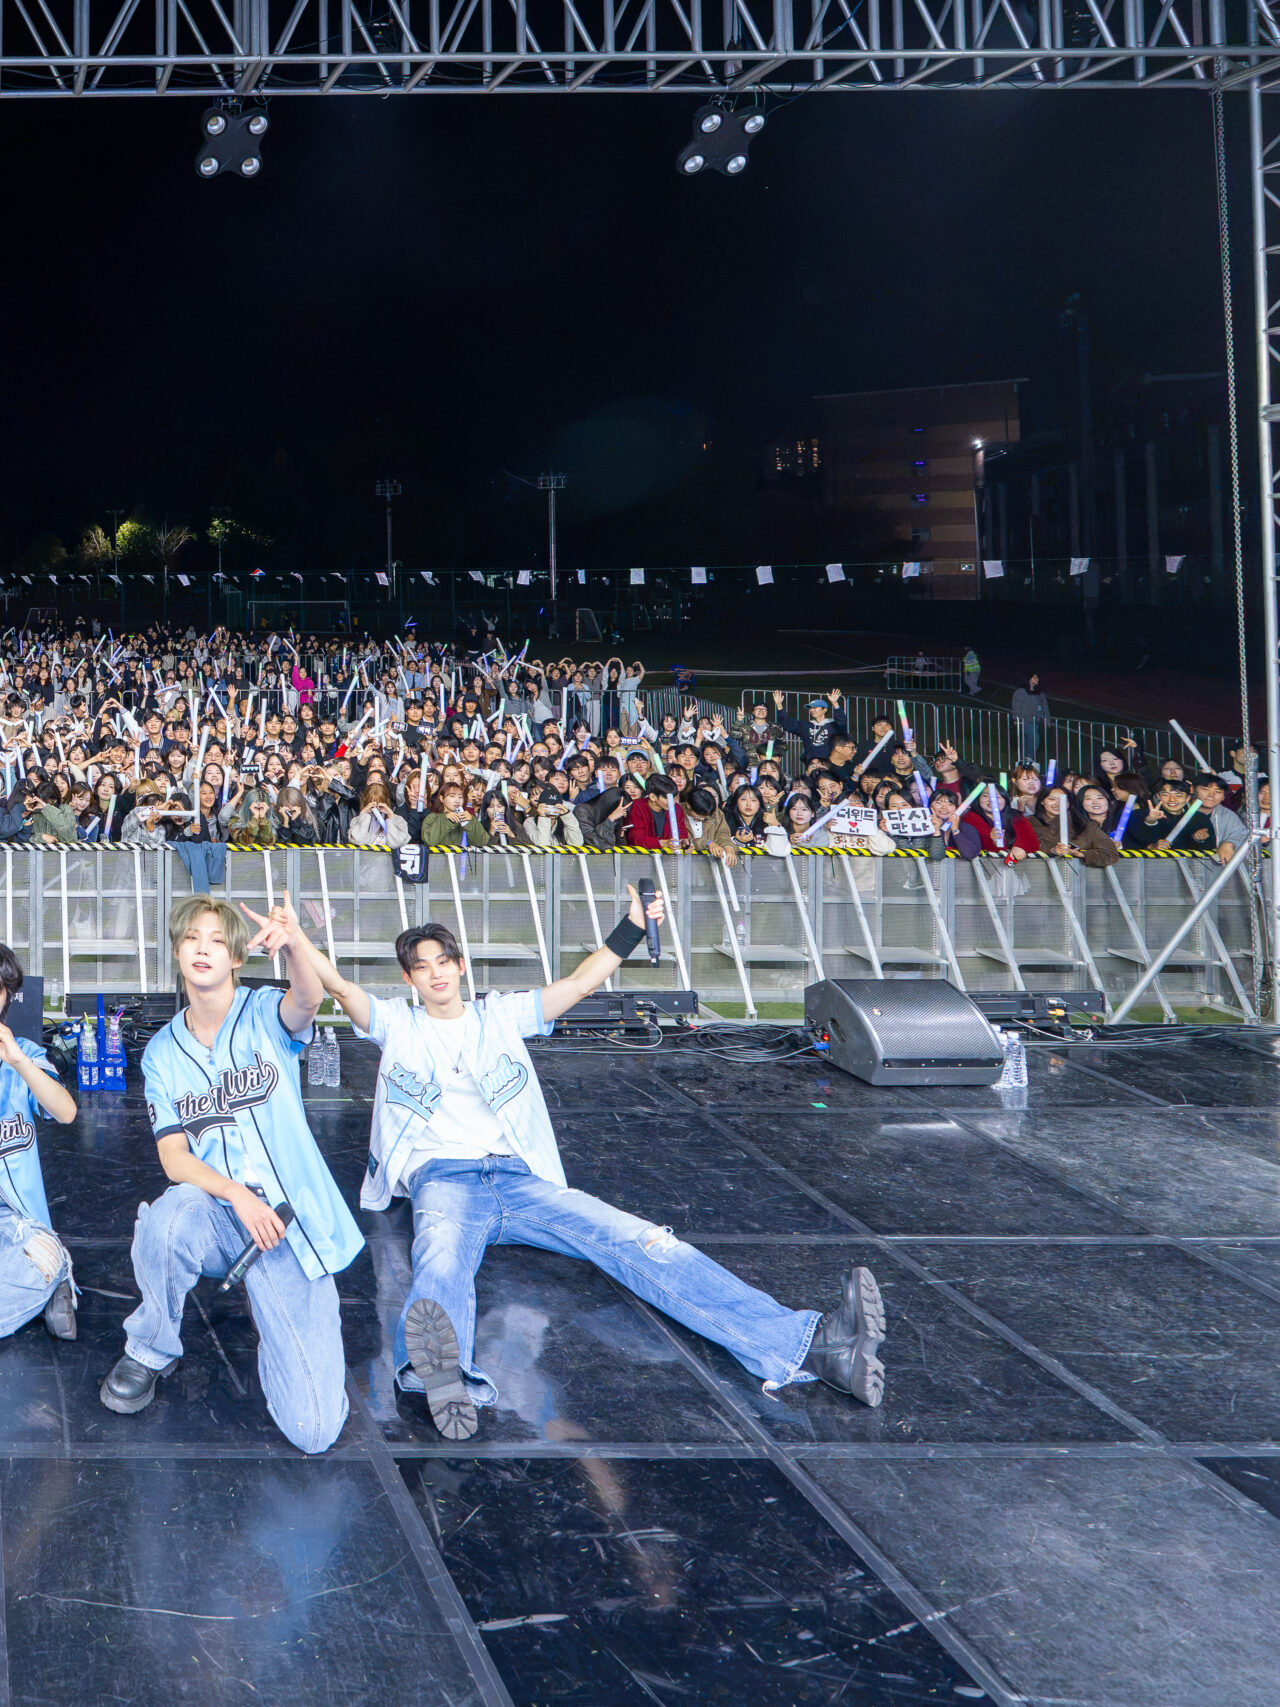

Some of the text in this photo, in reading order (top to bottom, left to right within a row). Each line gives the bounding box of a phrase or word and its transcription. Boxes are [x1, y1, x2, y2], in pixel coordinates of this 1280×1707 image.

[836, 807, 875, 822] 더윈드
[887, 809, 928, 821] 다시
[890, 822, 930, 834] 만나
[173, 1091, 213, 1123] The
